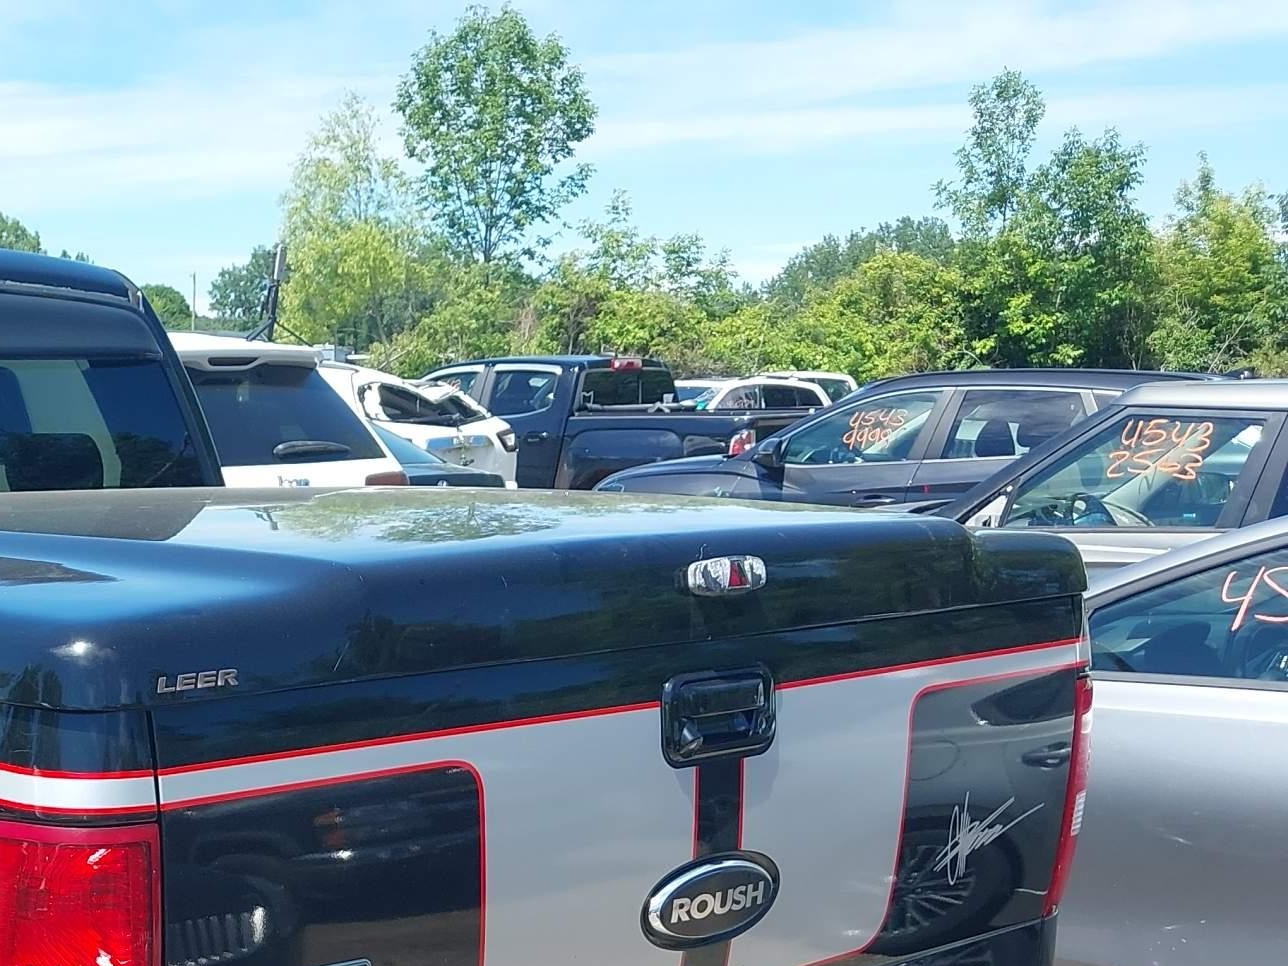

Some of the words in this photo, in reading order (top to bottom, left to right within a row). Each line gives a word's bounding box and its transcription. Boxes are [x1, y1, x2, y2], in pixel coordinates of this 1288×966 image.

[1121, 419, 1214, 452] 4543
[157, 668, 239, 693] LEER
[670, 881, 765, 924] ROUSH
